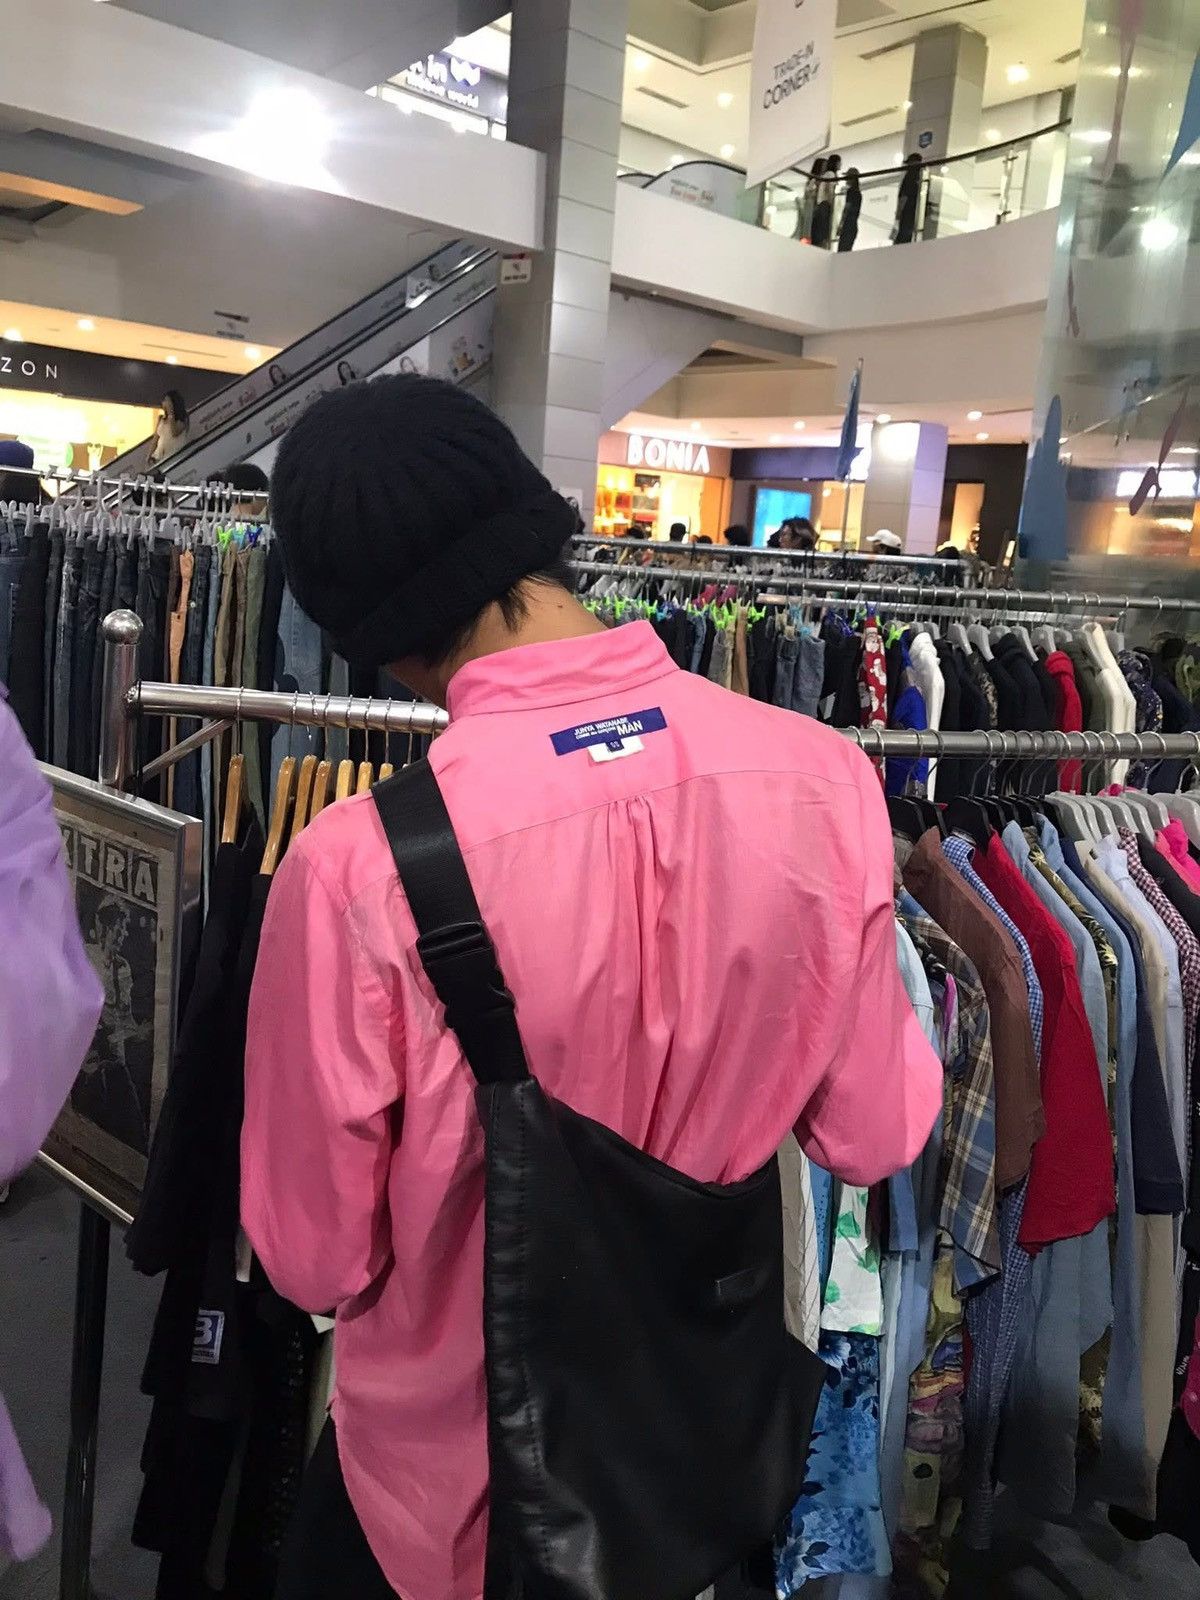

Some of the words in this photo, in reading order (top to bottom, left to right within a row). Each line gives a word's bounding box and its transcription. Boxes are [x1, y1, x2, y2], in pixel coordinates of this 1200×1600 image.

[763, 64, 810, 109] CORNER
[1, 356, 57, 379] ZON
[627, 435, 710, 474] BONIA
[574, 725, 595, 736] JUNYA
[595, 717, 628, 730] WATANABE
[616, 720, 644, 736] MAN
